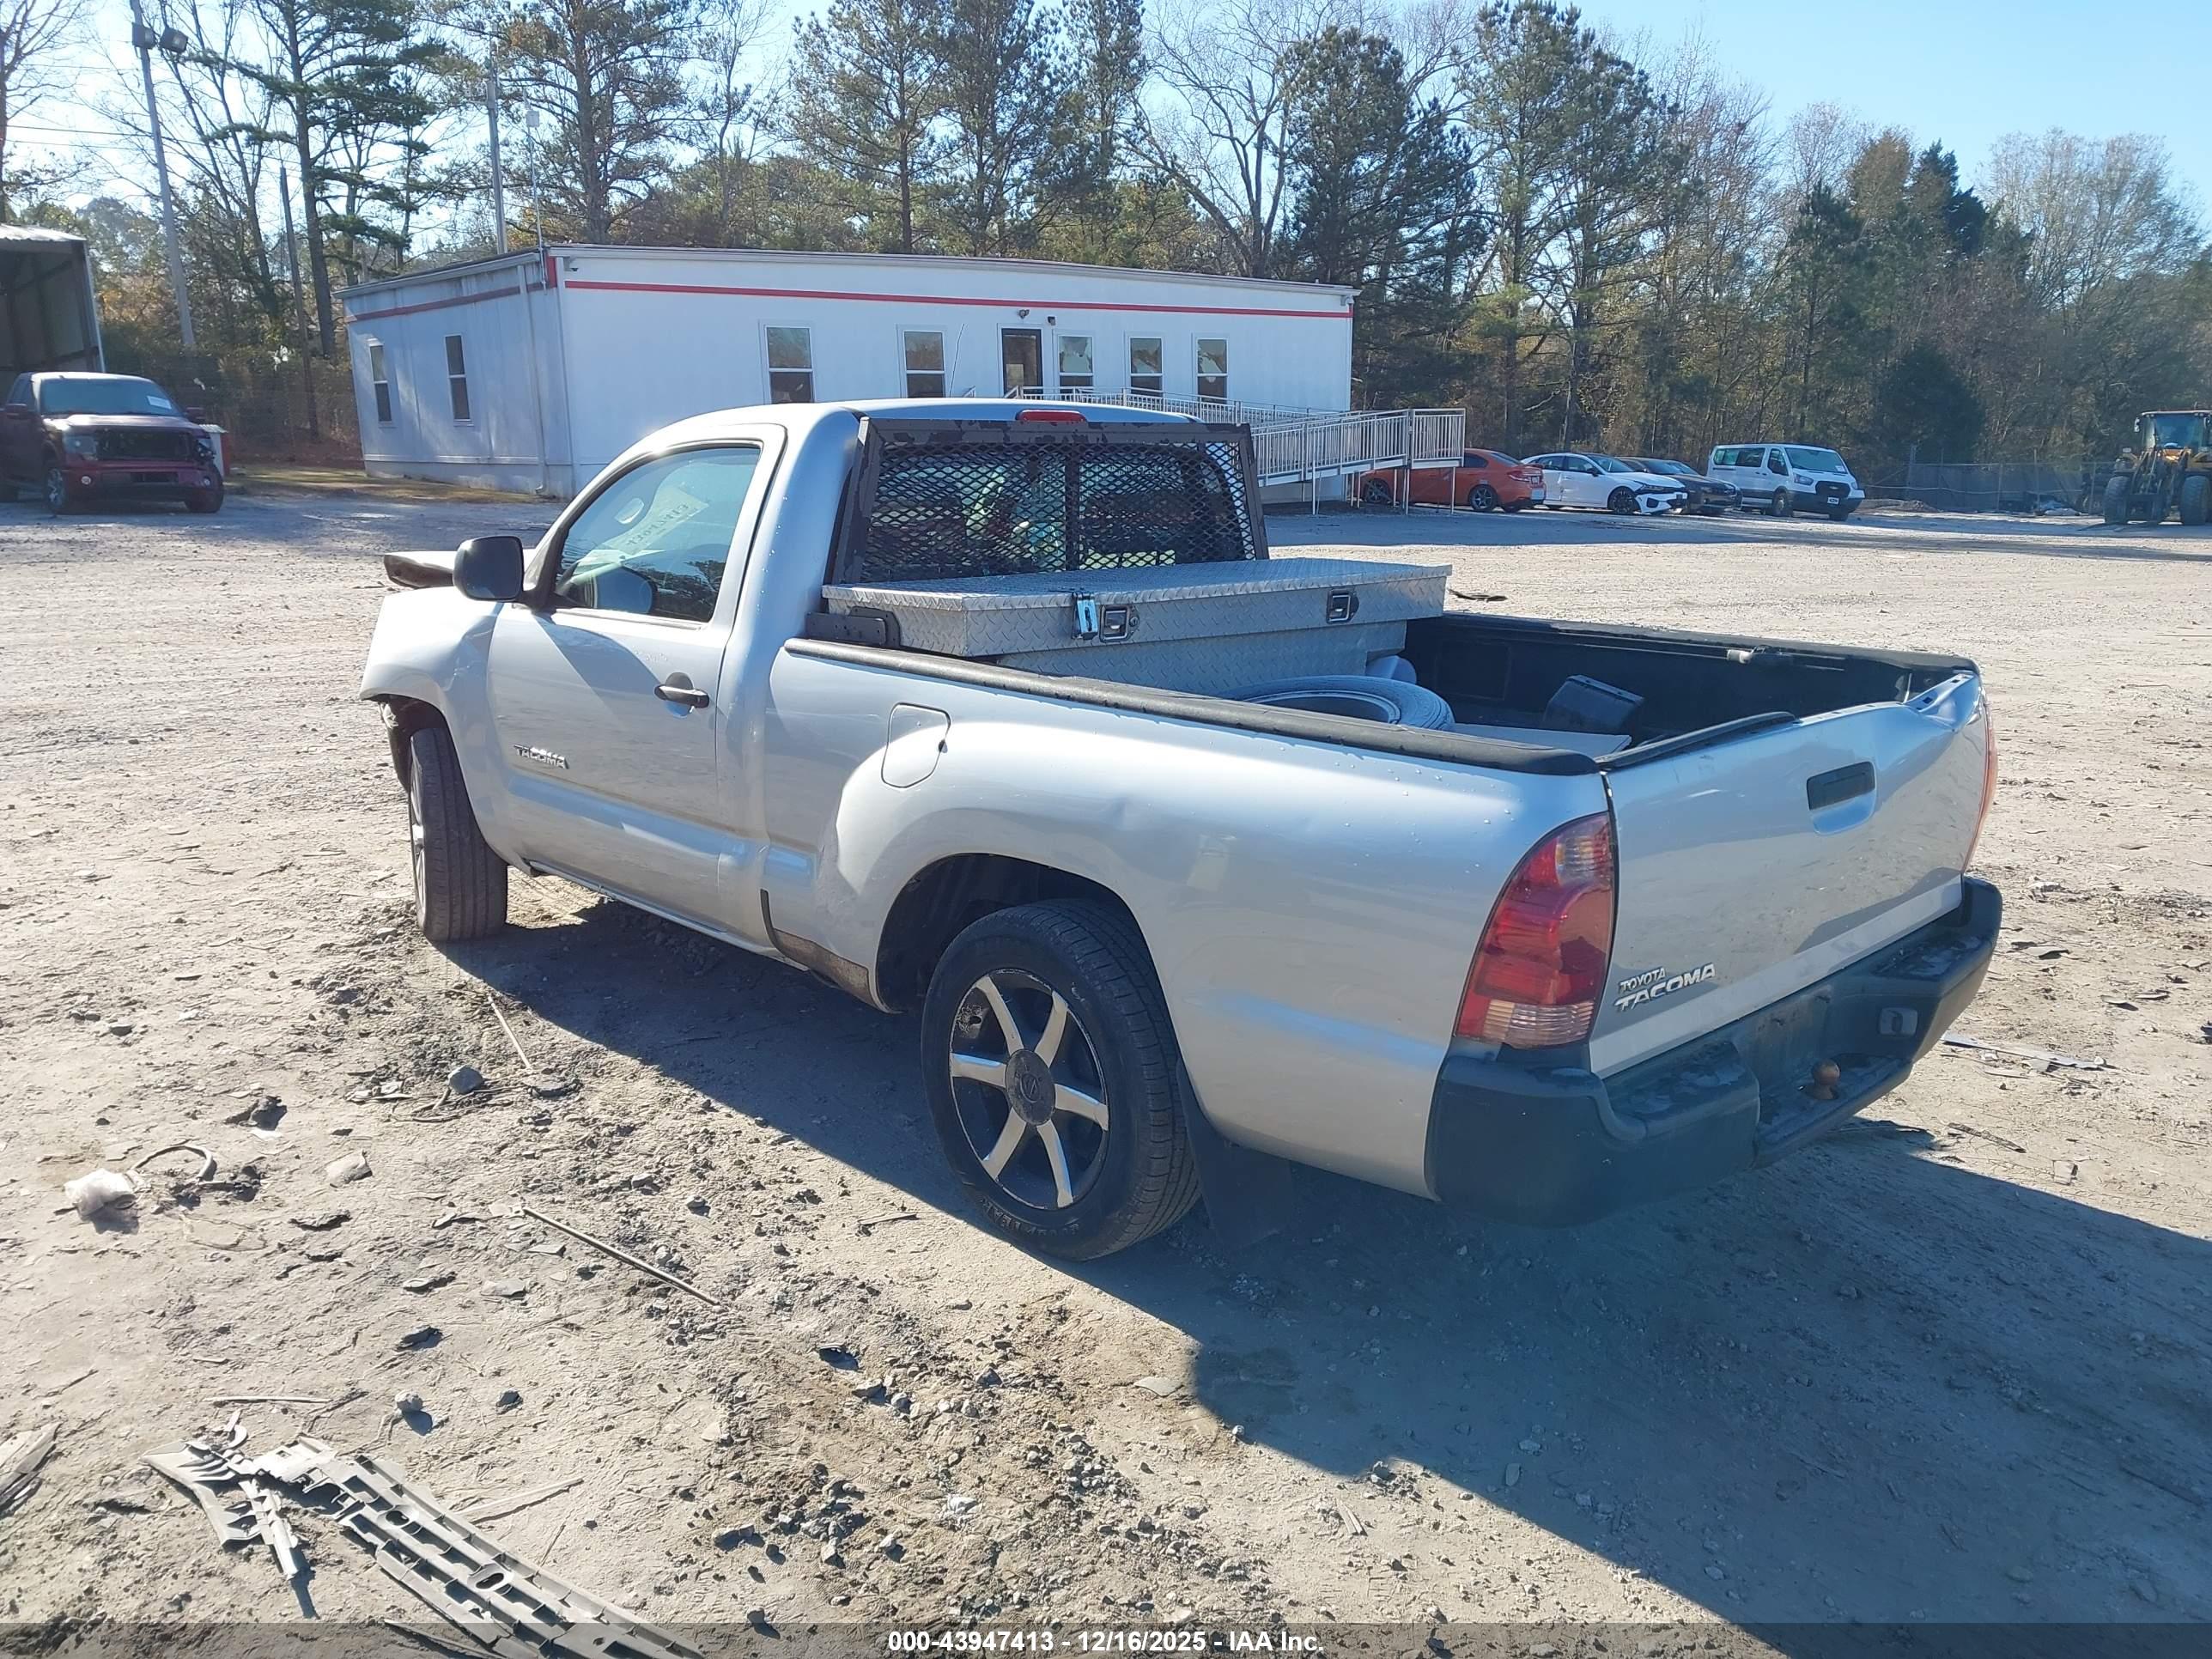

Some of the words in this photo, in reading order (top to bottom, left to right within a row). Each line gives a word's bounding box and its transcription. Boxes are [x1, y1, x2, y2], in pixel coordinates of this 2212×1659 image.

[514, 744, 568, 769] TACOMA
[1613, 963, 1716, 1011] TACOMA
[1619, 967, 1666, 992] TOYOTA
